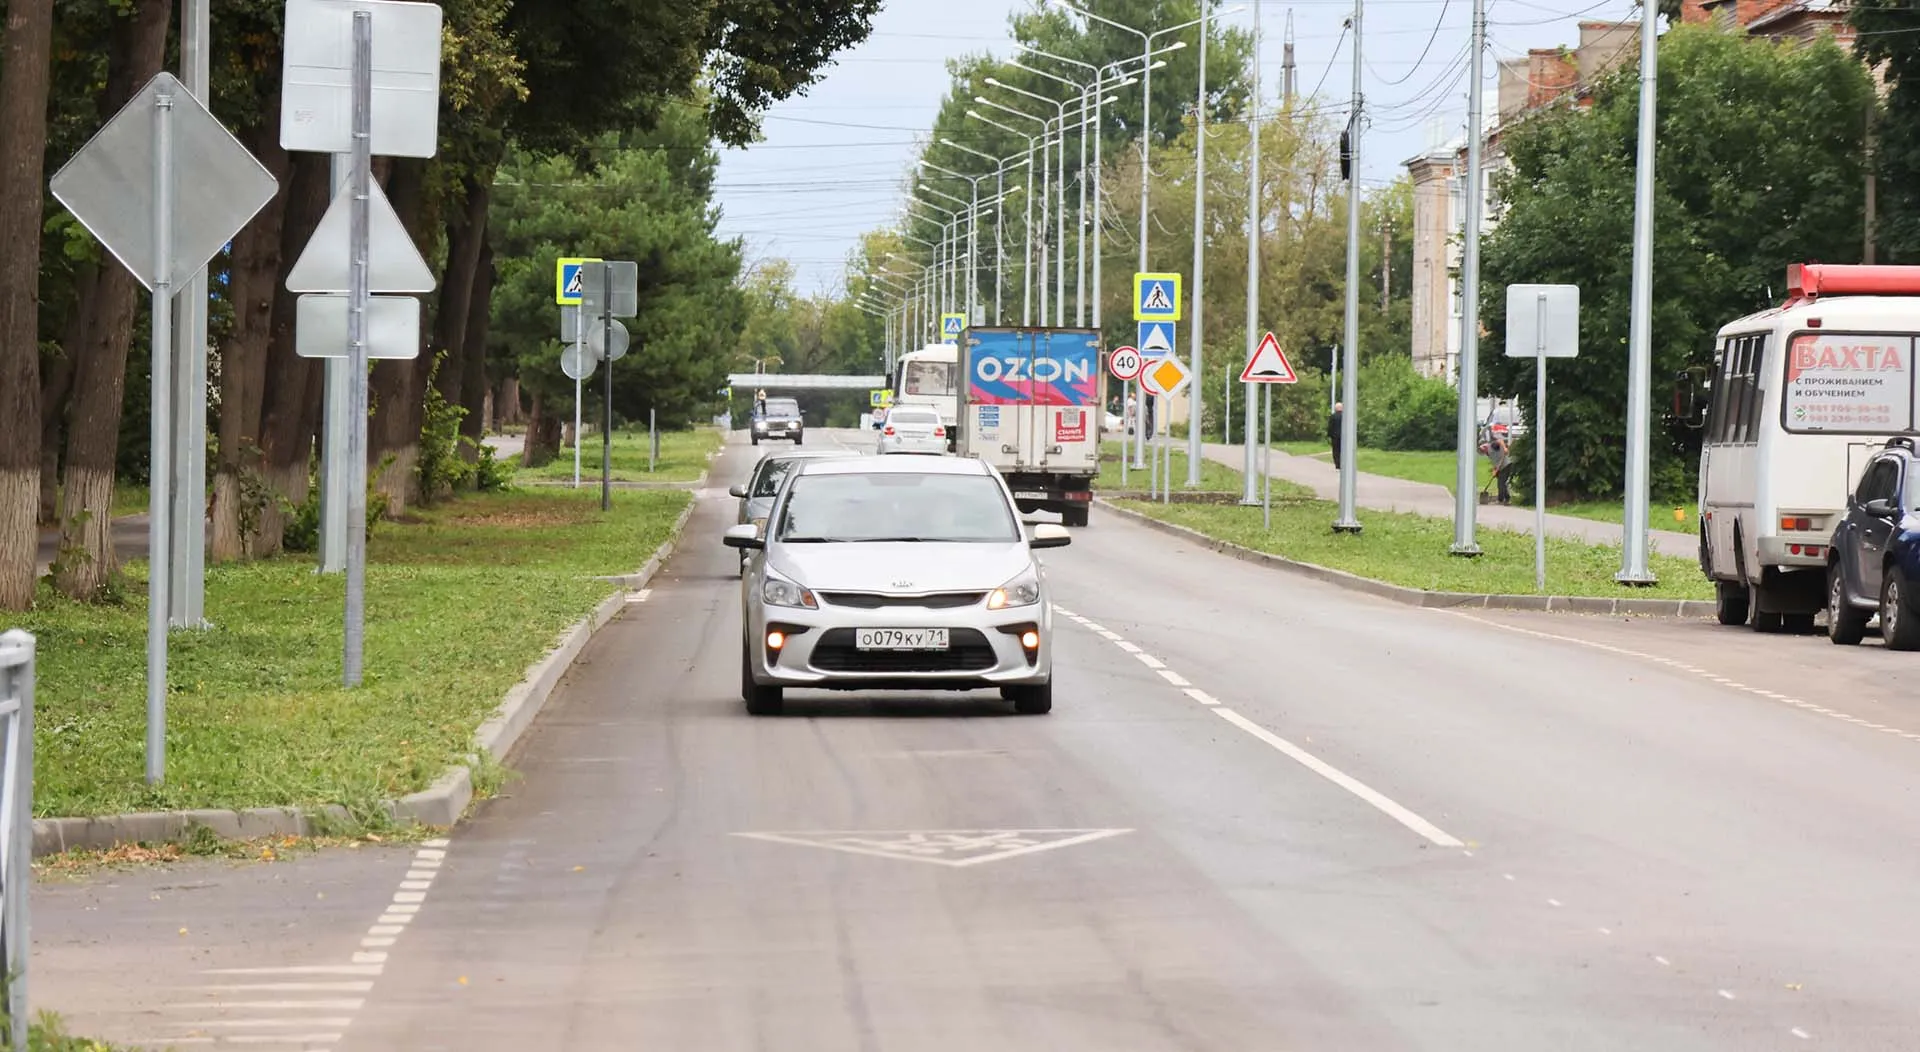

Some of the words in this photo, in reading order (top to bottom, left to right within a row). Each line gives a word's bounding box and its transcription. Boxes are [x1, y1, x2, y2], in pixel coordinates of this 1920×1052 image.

[1116, 356, 1136, 369] 40
[1796, 344, 1903, 371] ВАХТА
[977, 356, 1088, 382] OZON
[1795, 378, 1802, 386] С
[1804, 377, 1884, 386] ПРОЖИВАНИЕМ
[1795, 389, 1802, 397] И
[1804, 389, 1866, 397] ОБУЧЕНИЕМ
[928, 630, 944, 641] 71
